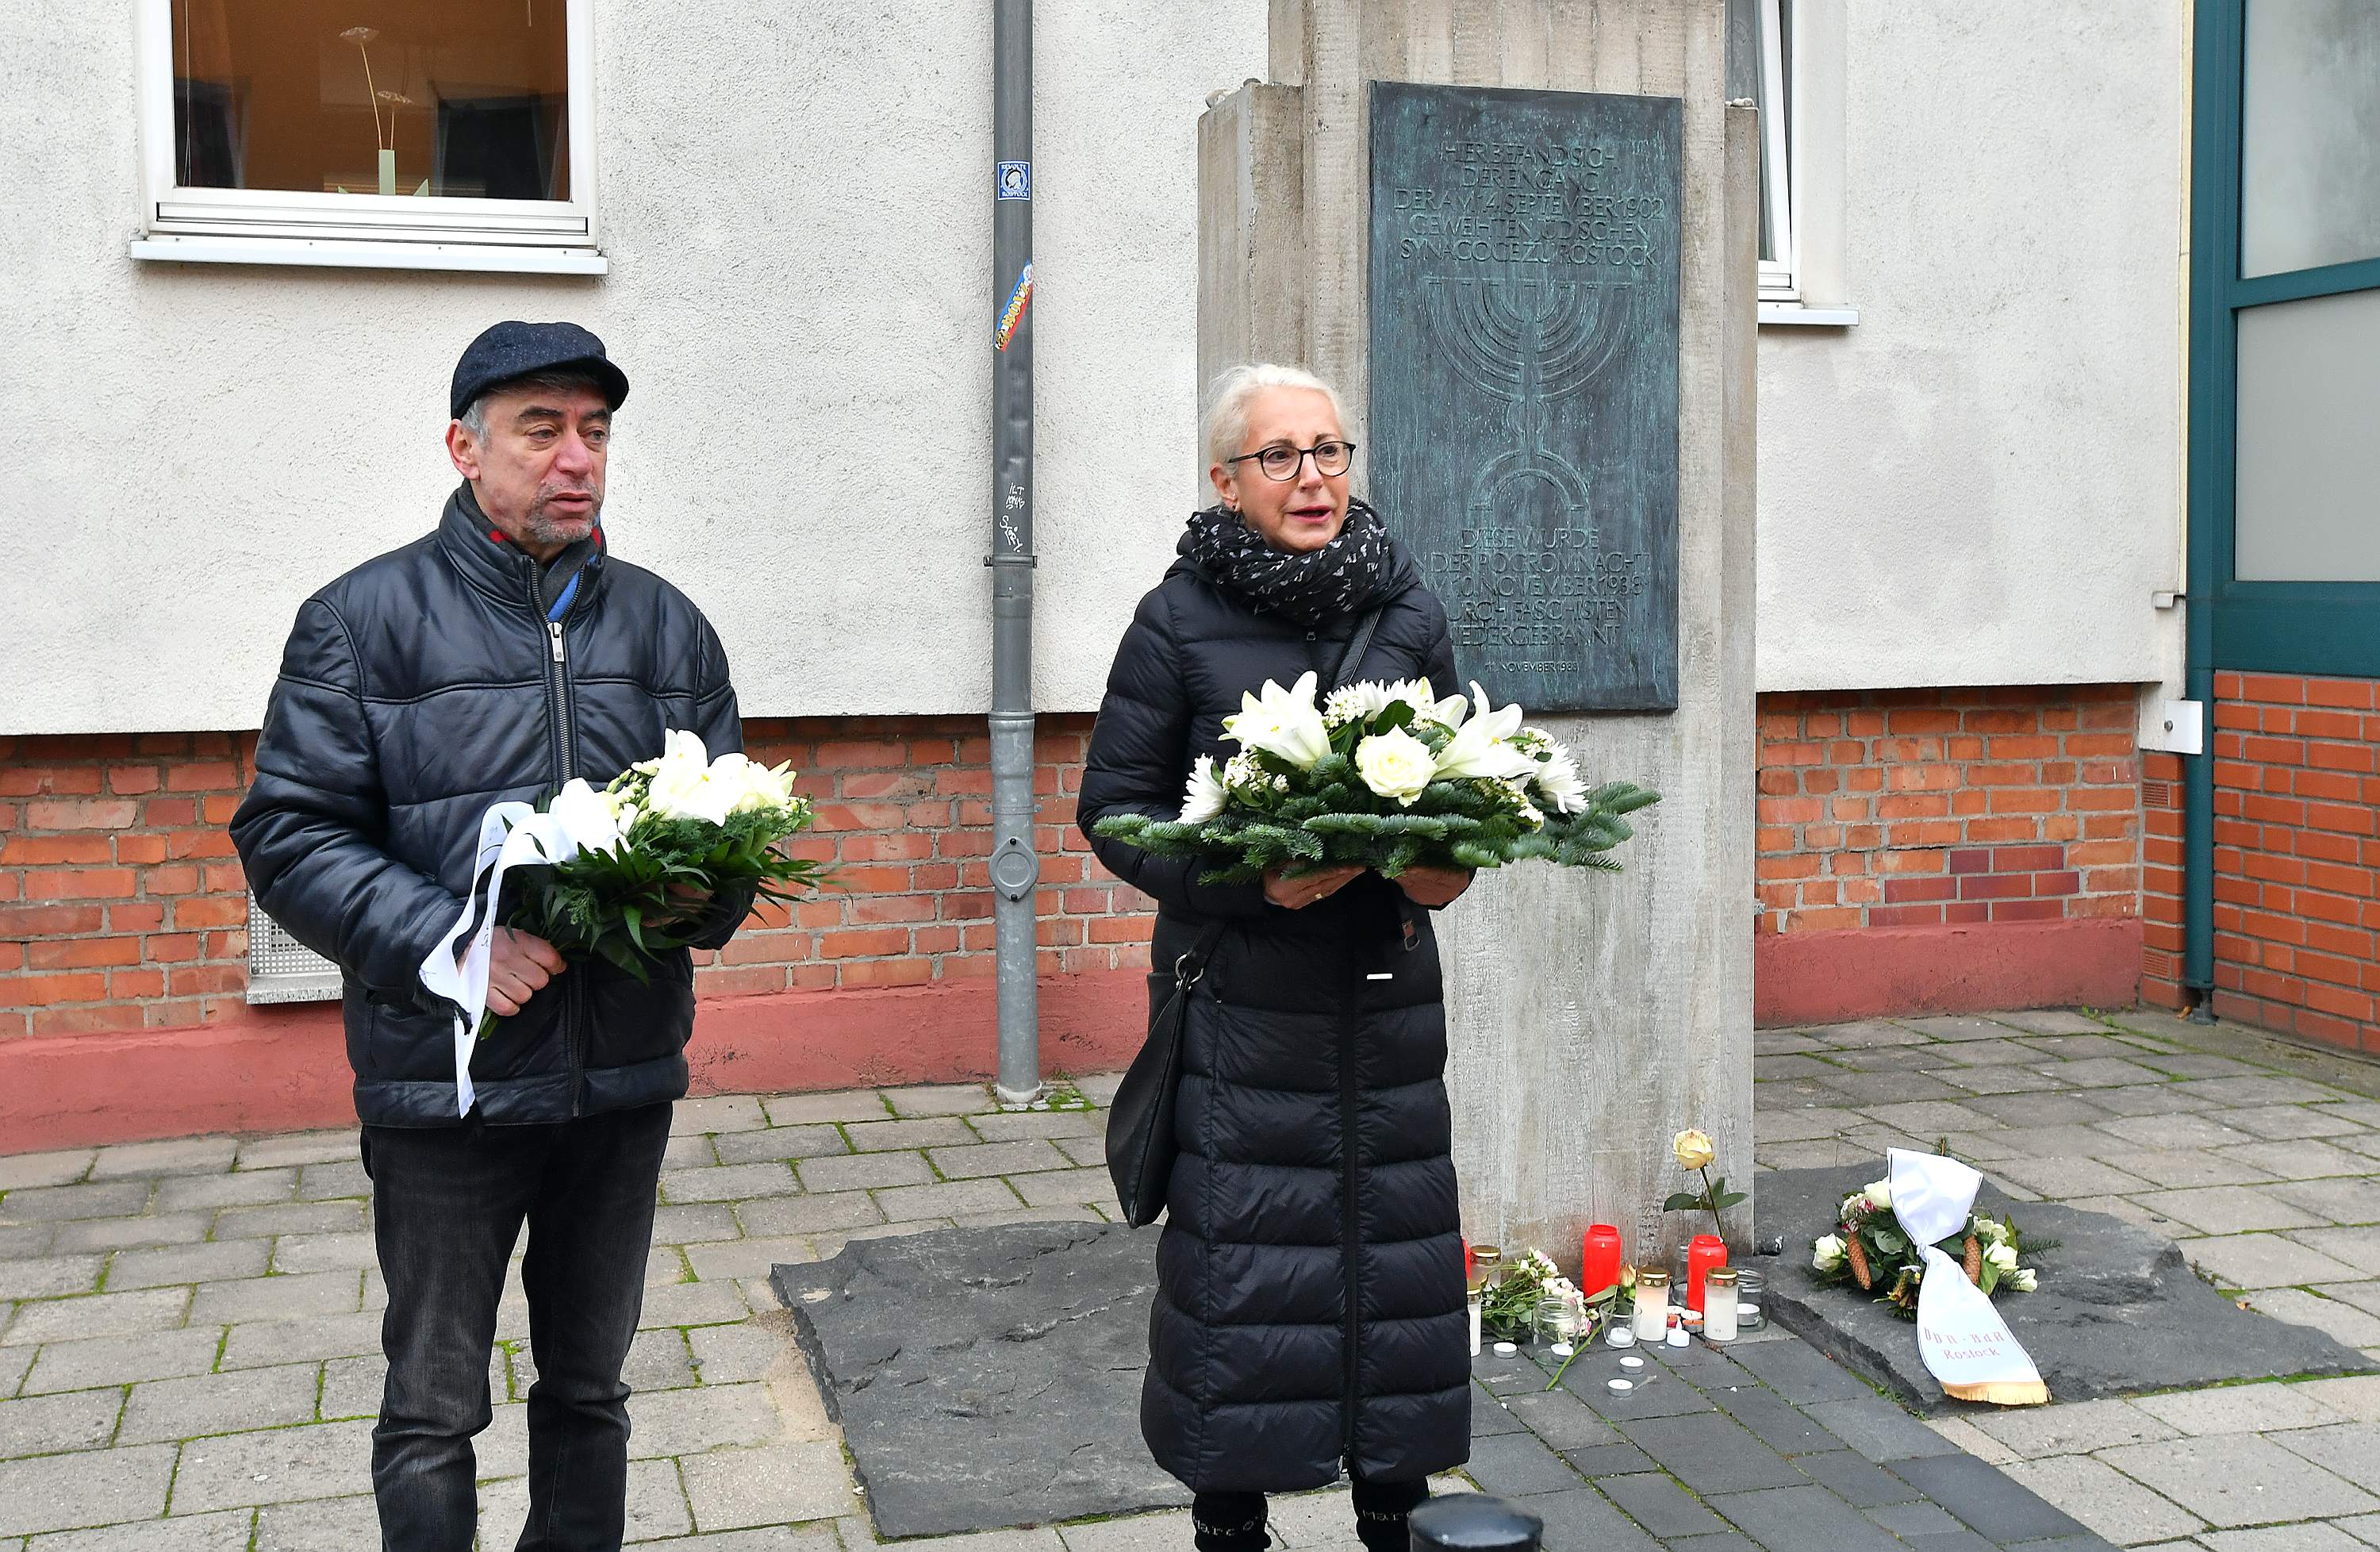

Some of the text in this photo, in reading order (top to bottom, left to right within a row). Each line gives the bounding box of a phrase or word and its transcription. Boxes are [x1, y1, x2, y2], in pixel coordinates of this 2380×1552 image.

[1440, 140, 1488, 163] HIER
[1491, 142, 1569, 167] BEFAND
[1461, 166, 1601, 192] DER EINGANG
[1394, 187, 1438, 211] DER
[1439, 190, 1476, 212] AM
[1505, 193, 1618, 217] SEPTEMBER
[1617, 197, 1664, 221] 1902
[1409, 213, 1534, 239] GEWEIHTEN
[1400, 239, 1657, 267] SYNAGOGE ZU ROSTOCK
[1461, 528, 1599, 550] DIESE WURDE
[1430, 551, 1472, 573] DER
[1477, 551, 1651, 573] POGROMNACHT
[1480, 576, 1597, 597] NOVEMBER
[1599, 576, 1644, 596] 1938
[1442, 599, 1630, 623] URCH FASCHISTEN
[1450, 624, 1622, 647] IEDERGEBRANNT
[1500, 660, 1557, 673] NOVEMBER
[1941, 1347, 2000, 1360] Rostock
